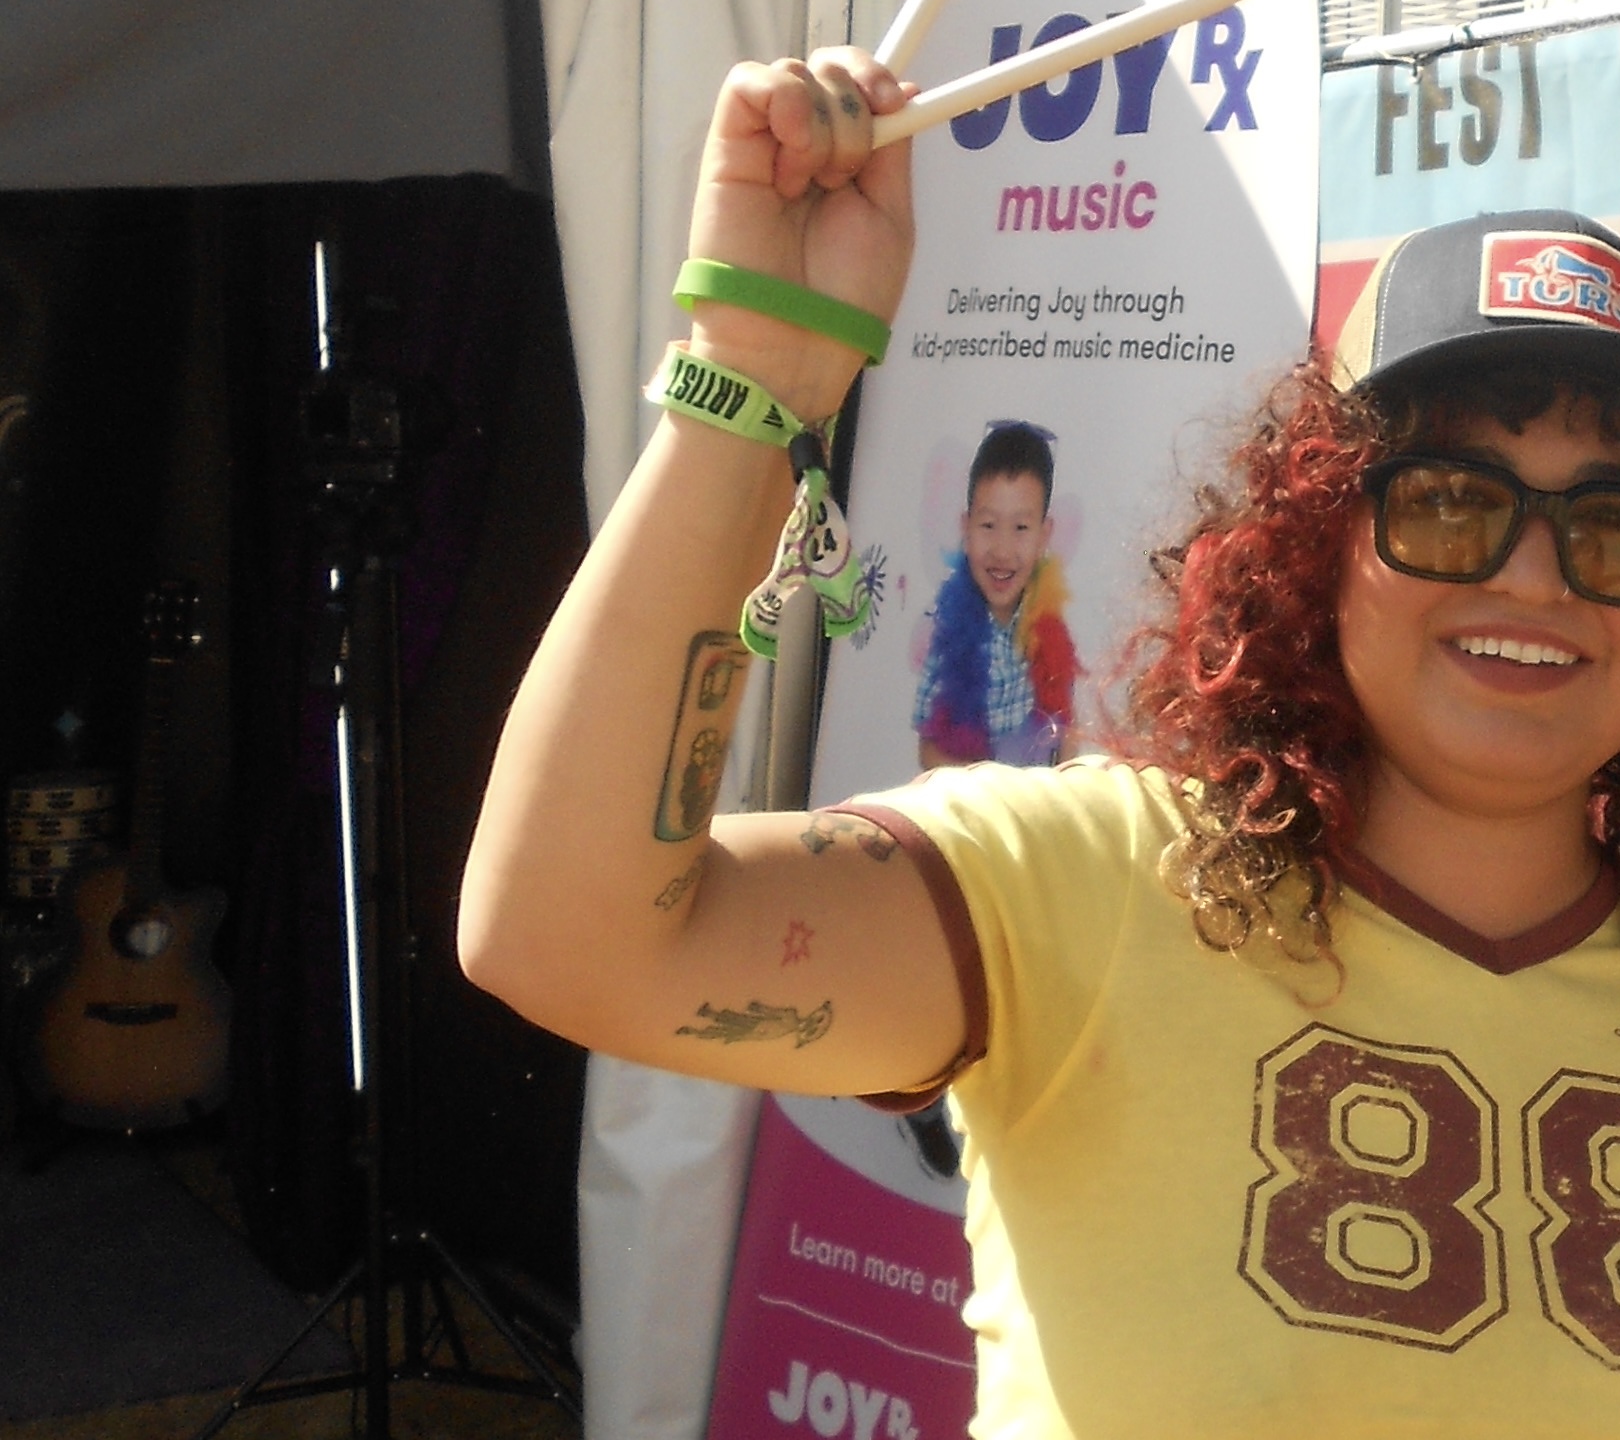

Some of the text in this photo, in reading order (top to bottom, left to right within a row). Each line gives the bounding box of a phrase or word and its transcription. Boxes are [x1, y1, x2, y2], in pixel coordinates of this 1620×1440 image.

[1375, 40, 1543, 177] FEST
[996, 160, 1158, 233] music
[947, 286, 1185, 322] Delivering Joy through
[911, 330, 1236, 364] kid-prescribed music medicine
[665, 358, 750, 421] ARTIST
[790, 1222, 960, 1308] Learn more at
